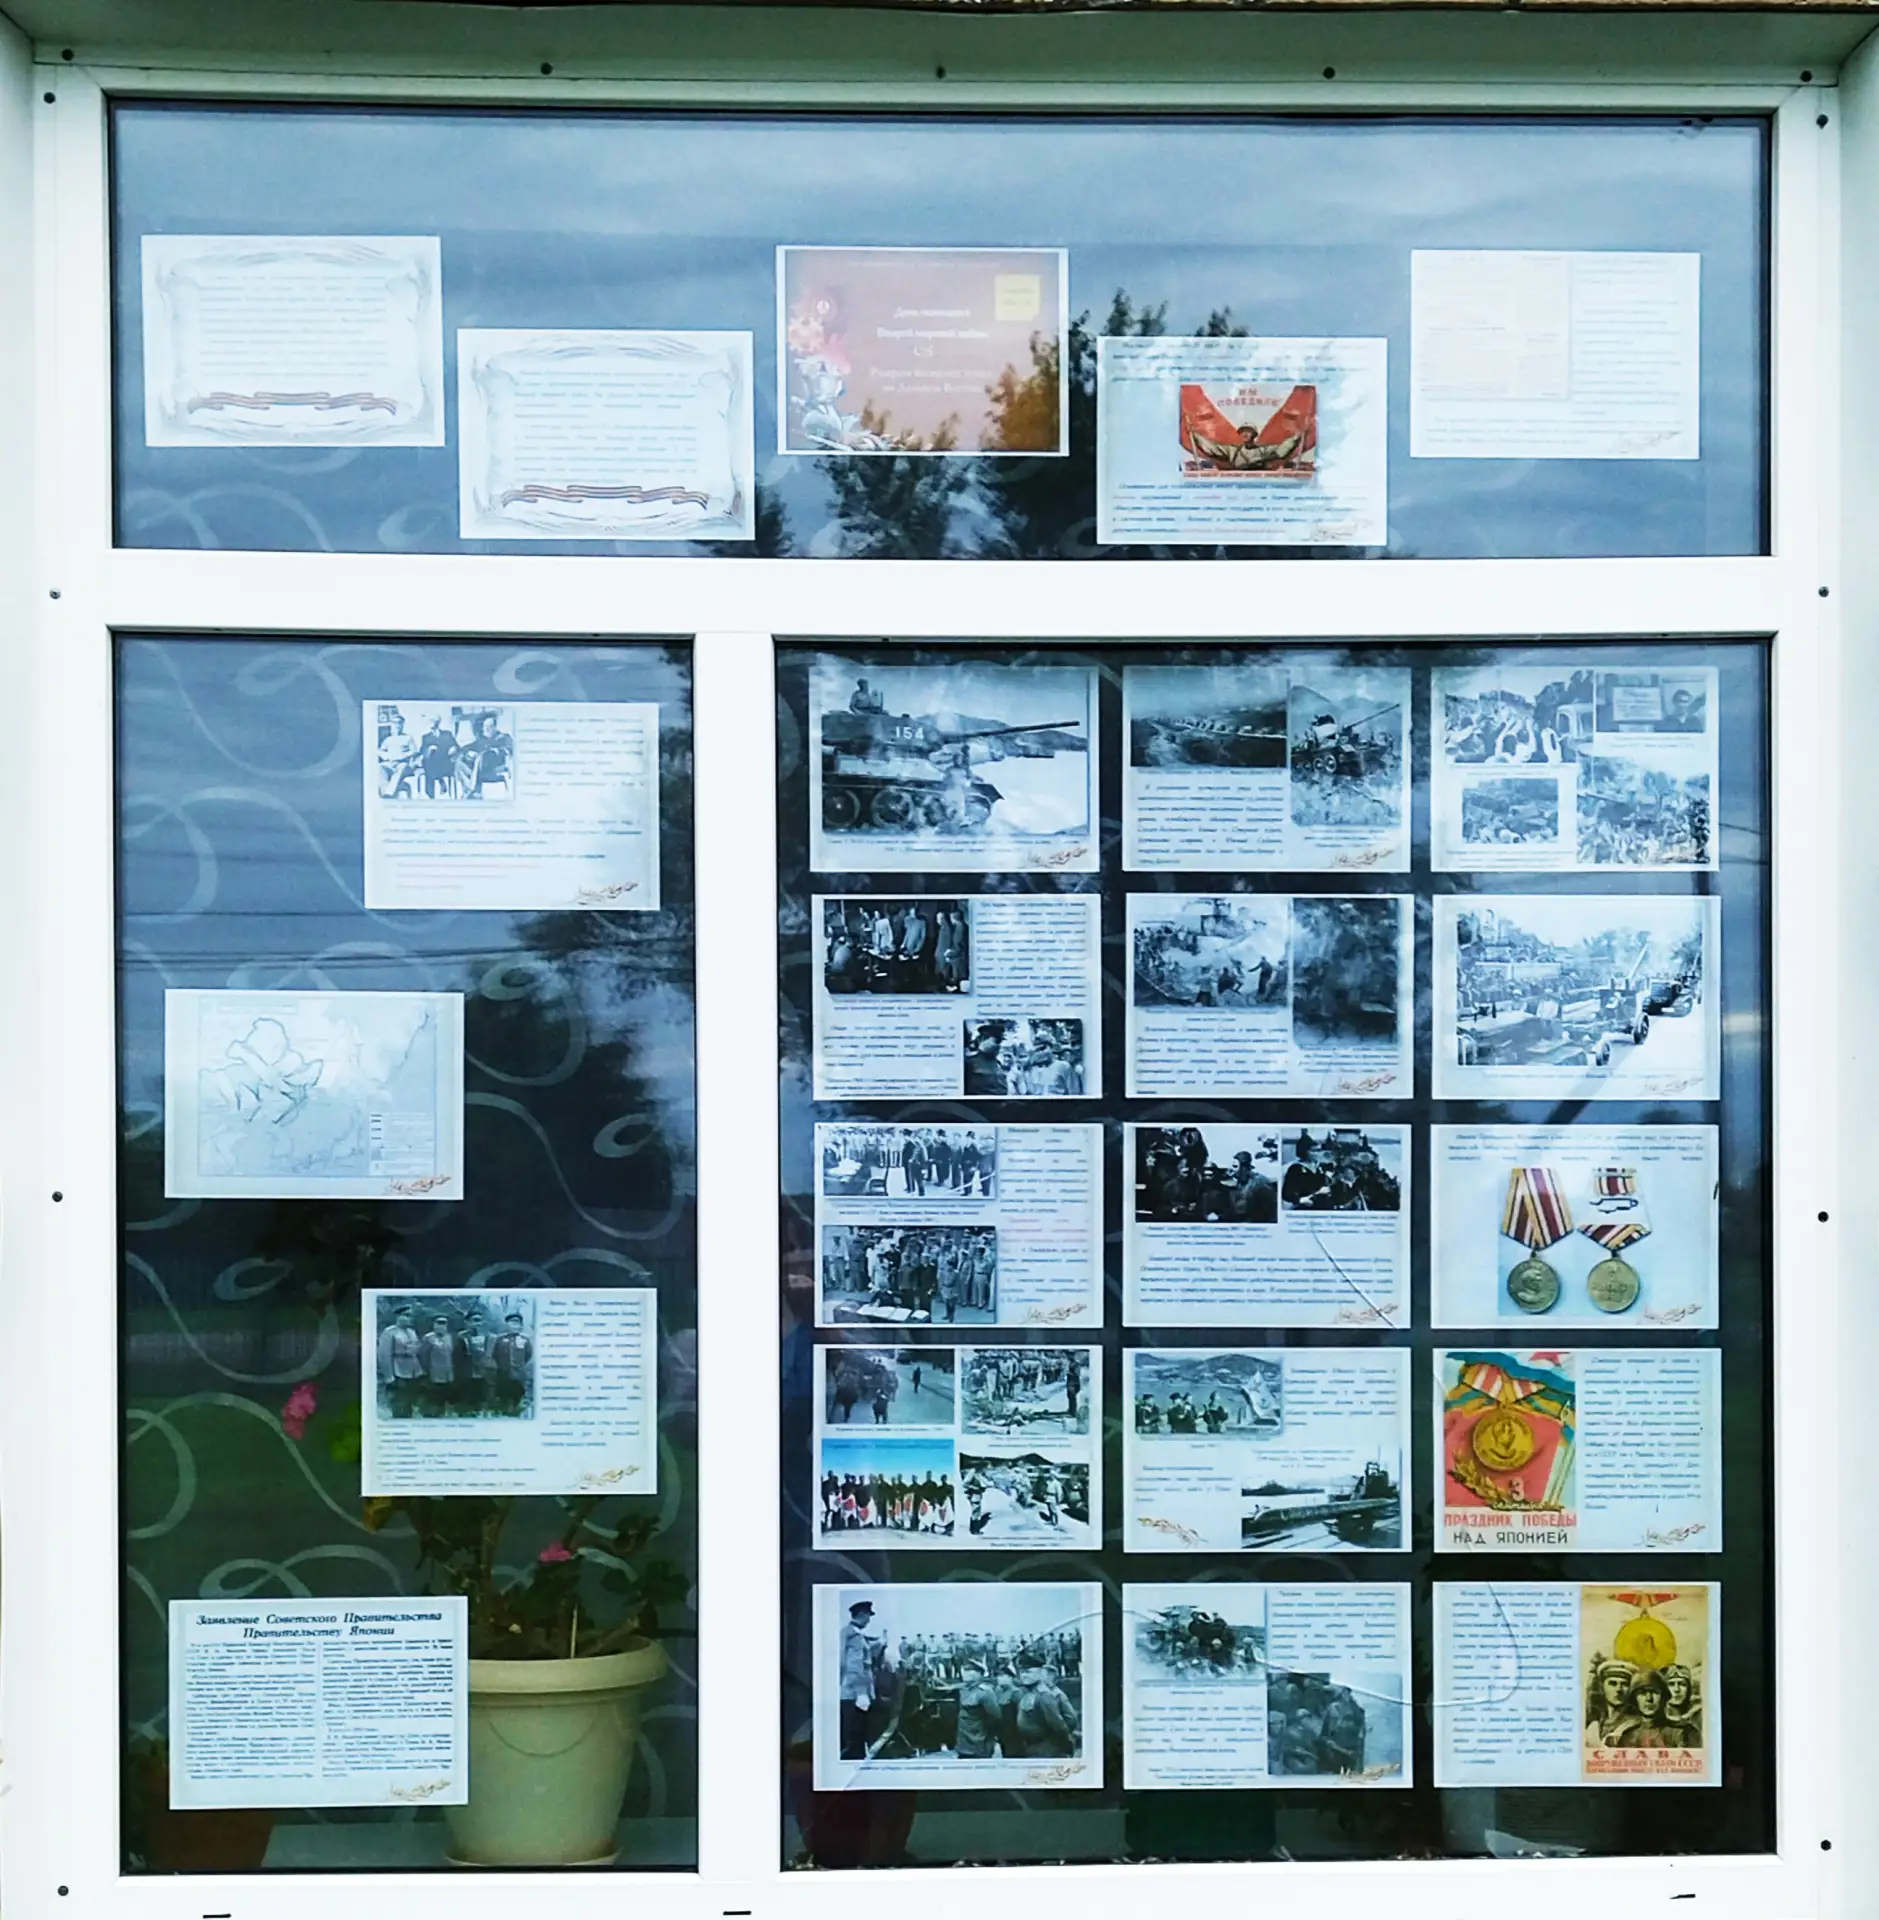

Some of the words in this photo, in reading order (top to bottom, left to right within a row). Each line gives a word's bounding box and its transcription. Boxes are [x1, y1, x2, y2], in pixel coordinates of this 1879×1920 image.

[896, 726, 925, 740] 154
[1444, 1513, 1512, 1528] ПРАЗДНИК
[1522, 1512, 1577, 1528] ПОБЕДЫ
[1453, 1531, 1486, 1545] НАД
[1496, 1529, 1568, 1544] ЯПОНИЕЙ
[196, 1615, 260, 1626] Заявление
[266, 1613, 338, 1625] Советского
[343, 1612, 442, 1623] Правительства
[243, 1627, 341, 1639] Правительству
[349, 1625, 395, 1636] Японии
[1593, 1750, 1693, 1760] СЛАВА
